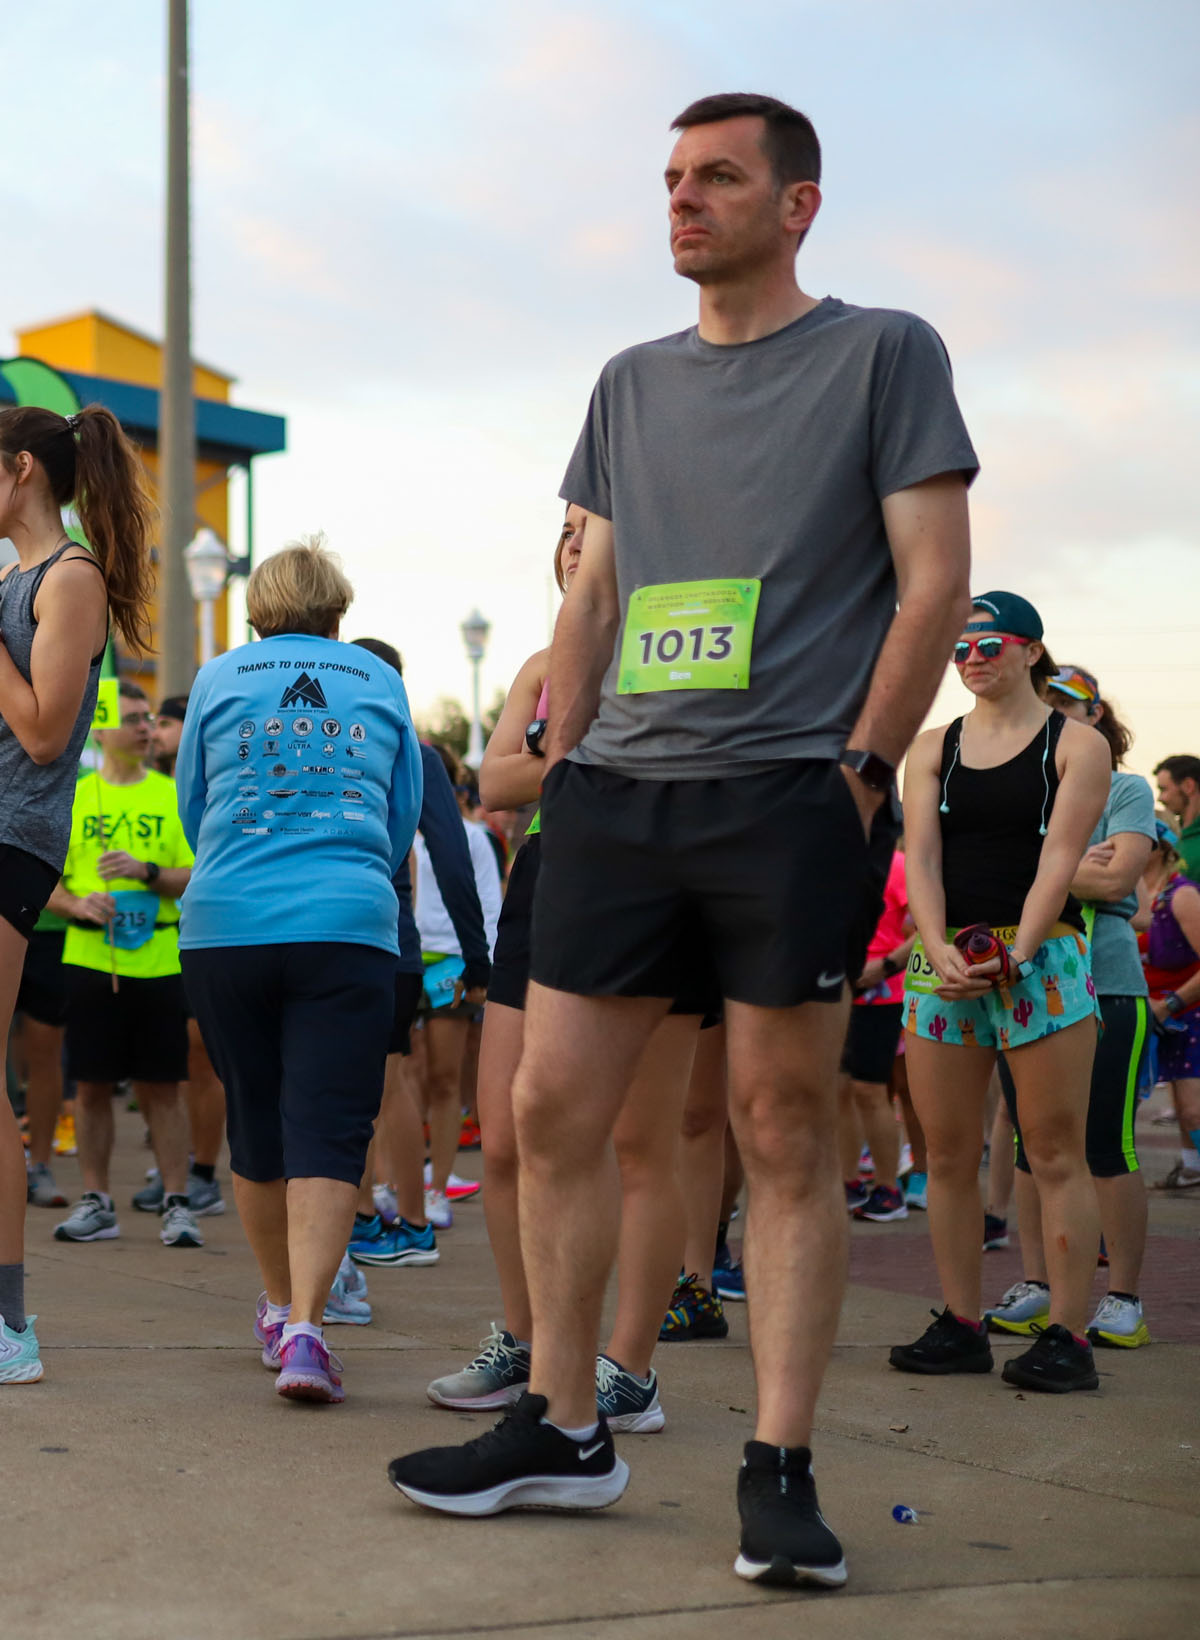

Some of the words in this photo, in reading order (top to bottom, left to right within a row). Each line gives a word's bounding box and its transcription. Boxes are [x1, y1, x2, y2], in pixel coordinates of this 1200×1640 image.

[640, 626, 734, 665] 1013
[237, 661, 276, 675] THANKS
[280, 661, 291, 669] TO
[294, 661, 315, 670] OUR
[318, 662, 371, 681] SPONSORS
[82, 812, 166, 843] BEAST
[907, 952, 939, 977] 103
